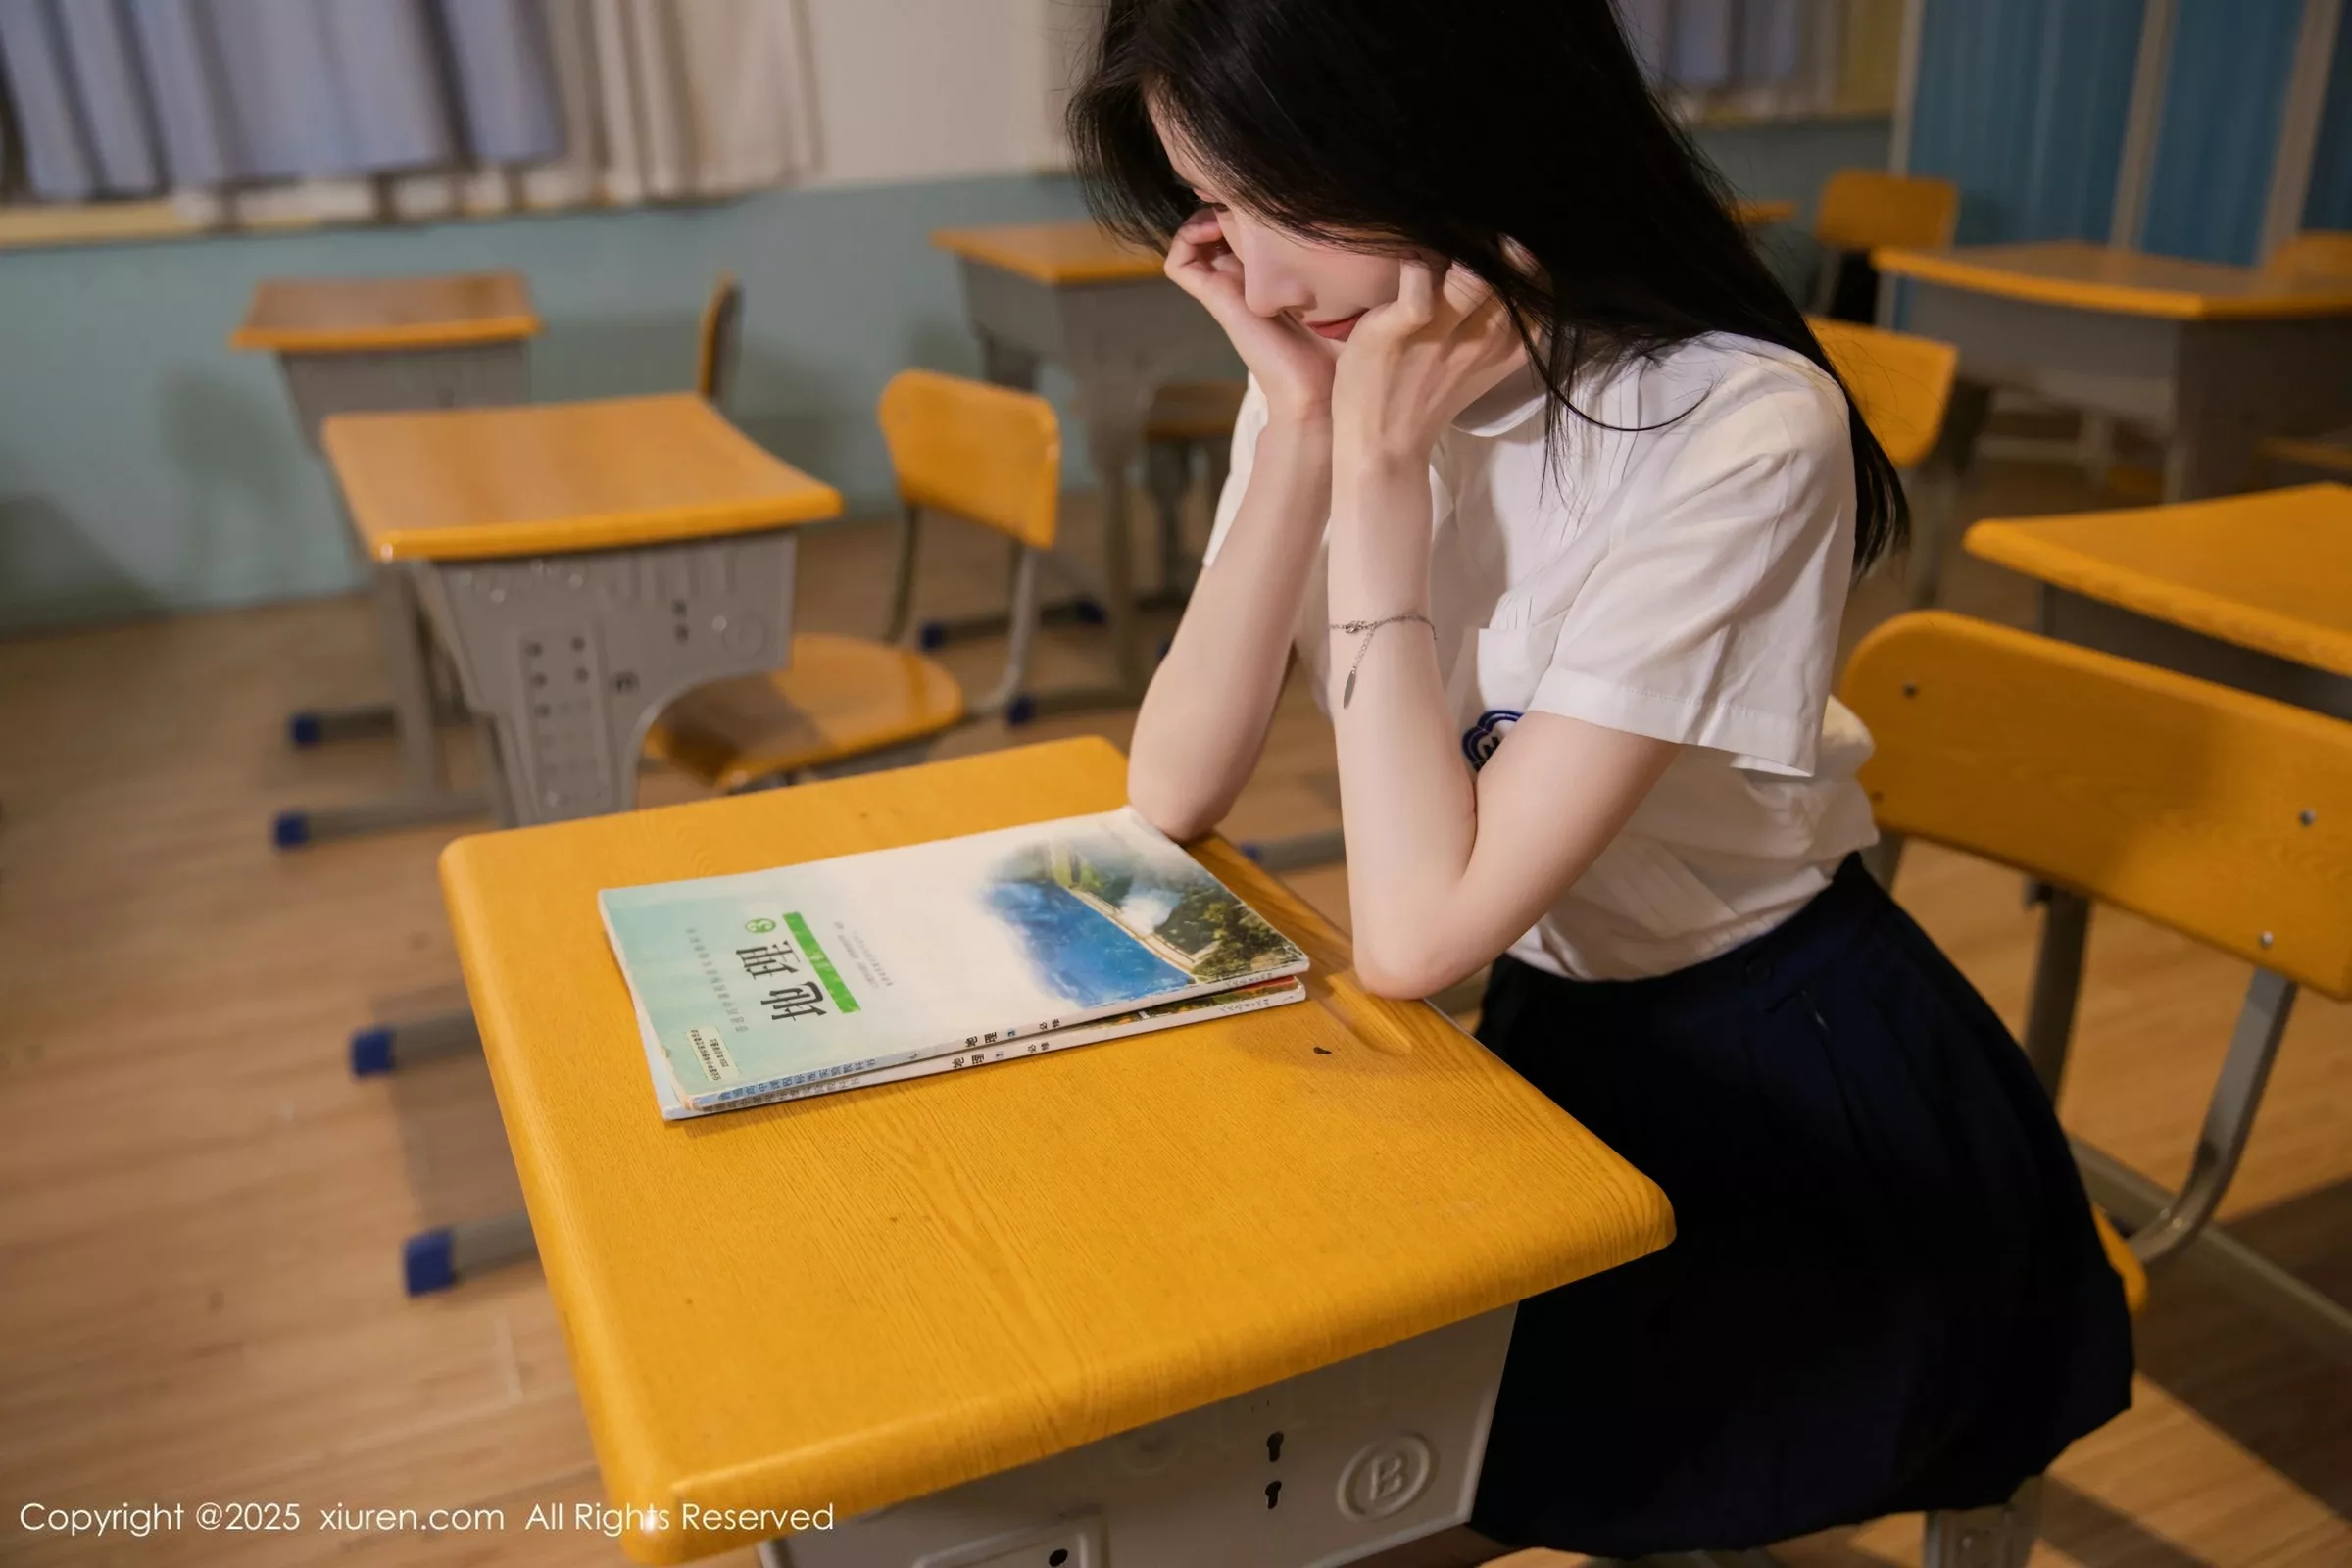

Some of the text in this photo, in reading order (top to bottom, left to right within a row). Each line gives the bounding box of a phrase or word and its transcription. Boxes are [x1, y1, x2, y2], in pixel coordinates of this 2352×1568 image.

[736, 939, 827, 1021] 地理
[964, 1031, 998, 1048] 地理
[952, 1053, 985, 1069] 地理
